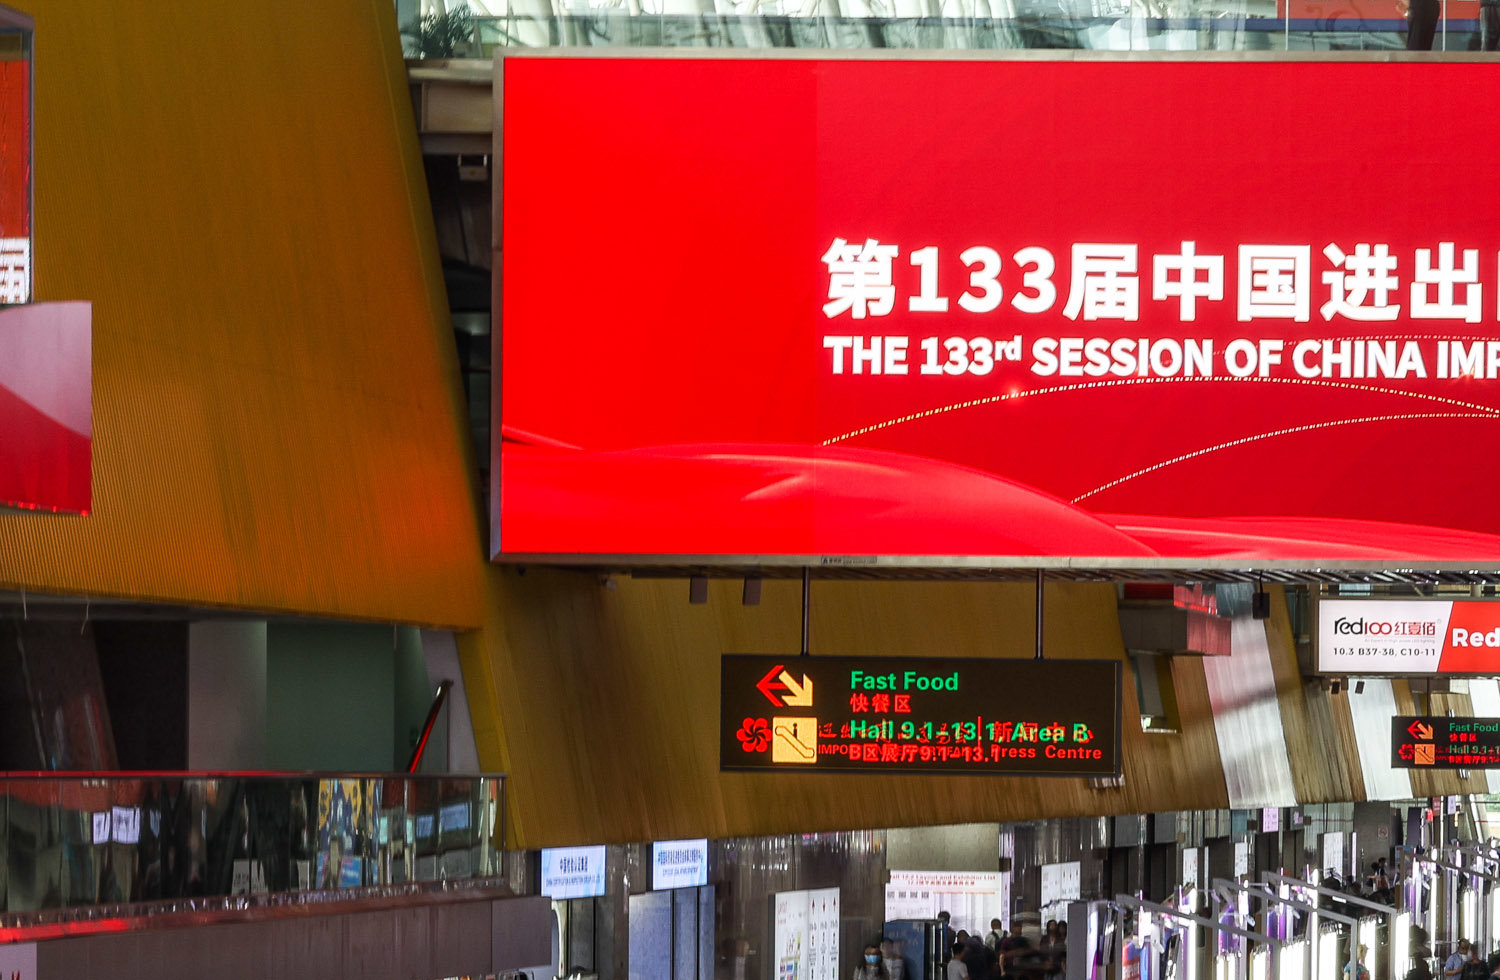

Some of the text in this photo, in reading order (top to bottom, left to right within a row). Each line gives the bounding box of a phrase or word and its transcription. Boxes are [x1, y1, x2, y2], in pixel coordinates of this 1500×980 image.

[824, 336, 908, 377] THE
[918, 336, 1023, 377] 133rd
[1032, 336, 1213, 378] SESSION
[1223, 338, 1284, 380] OF
[1292, 339, 1427, 380] CHINA
[1394, 621, 1436, 636] 红壹佰
[1334, 648, 1436, 658] 10.3 B37-38, C10-11
[850, 671, 959, 692] Fast Food
[850, 693, 911, 713] 快餐区
[850, 720, 893, 739] Hall
[1011, 722, 1065, 742] Area
[1074, 723, 1089, 741] B
[1449, 723, 1498, 732] Fast Food
[1045, 745, 1102, 760] Centre
